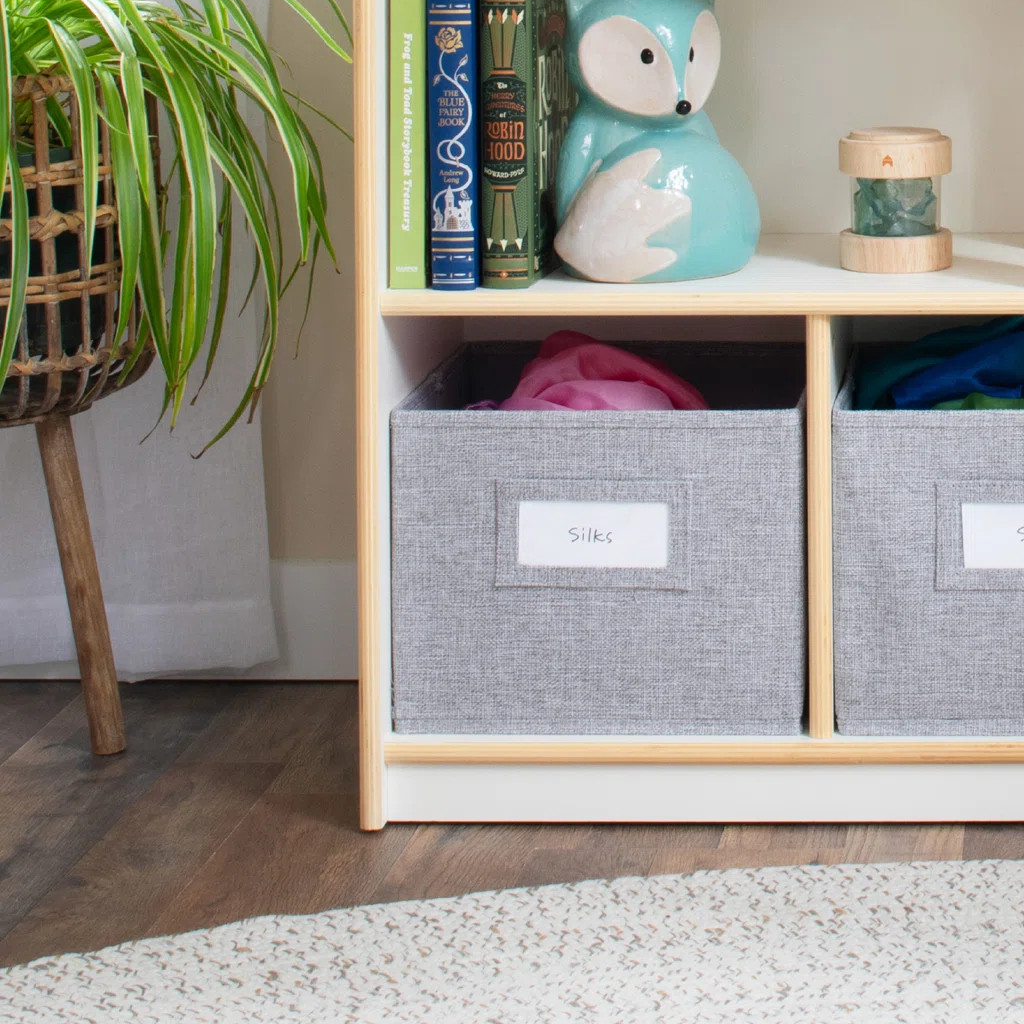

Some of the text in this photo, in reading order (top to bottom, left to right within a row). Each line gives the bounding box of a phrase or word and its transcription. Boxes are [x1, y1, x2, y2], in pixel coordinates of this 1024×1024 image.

[437, 97, 465, 107] BLUE
[439, 108, 464, 117] FAIRY
[438, 118, 465, 127] BOOK
[401, 33, 413, 232] Frog and Toad Storybook Treasury
[485, 141, 525, 161] HOOD
[568, 527, 613, 543] Silks
